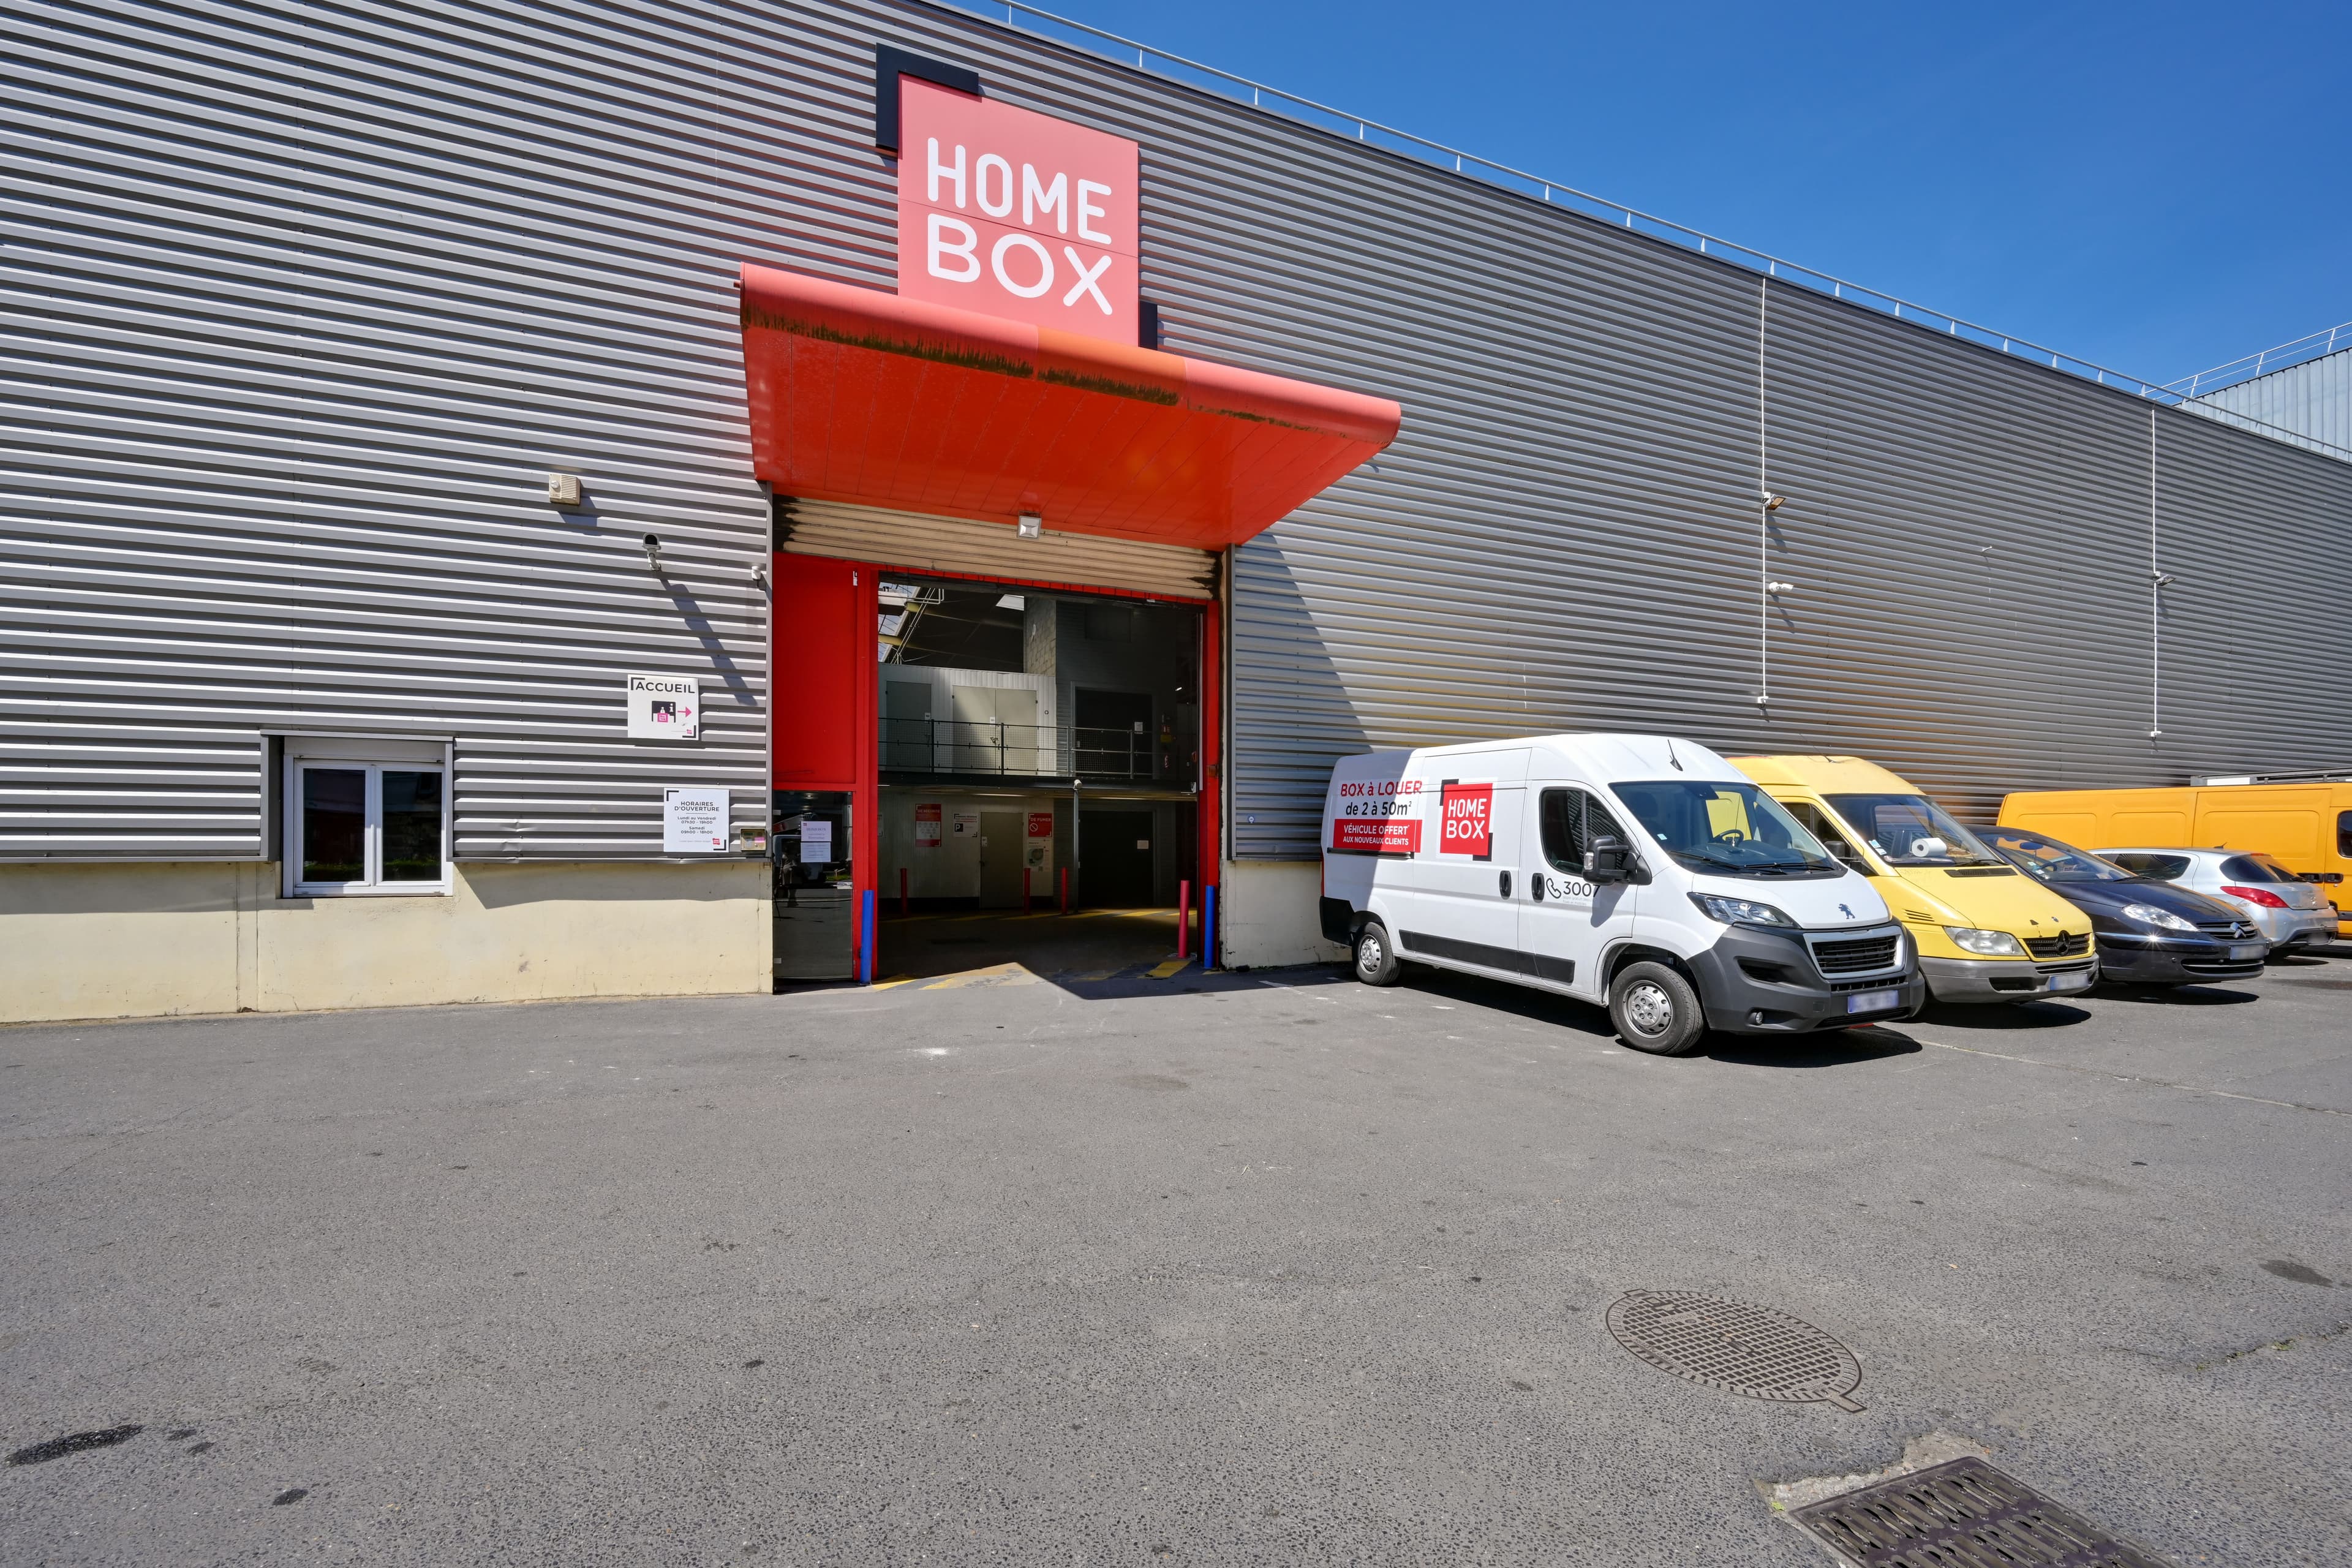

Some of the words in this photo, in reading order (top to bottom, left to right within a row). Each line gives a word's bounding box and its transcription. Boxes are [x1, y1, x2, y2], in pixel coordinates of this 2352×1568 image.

[928, 137, 1112, 245] HOME
[928, 213, 1113, 315] BOX
[635, 681, 695, 694] ACCUEIL
[1340, 783, 1365, 797] BOX
[1368, 782, 1374, 796] à
[1378, 780, 1423, 796] LOUER
[1346, 802, 1359, 815] de
[1362, 802, 1368, 815] 2
[1371, 801, 1378, 815] à
[1382, 801, 1412, 816] 50m²
[1448, 798, 1487, 818] HOME
[1344, 823, 1377, 835] VÉHICULE
[1446, 820, 1485, 839] BOX
[1385, 837, 1409, 846] CLIENTS
[1563, 881, 1600, 897] 3007
